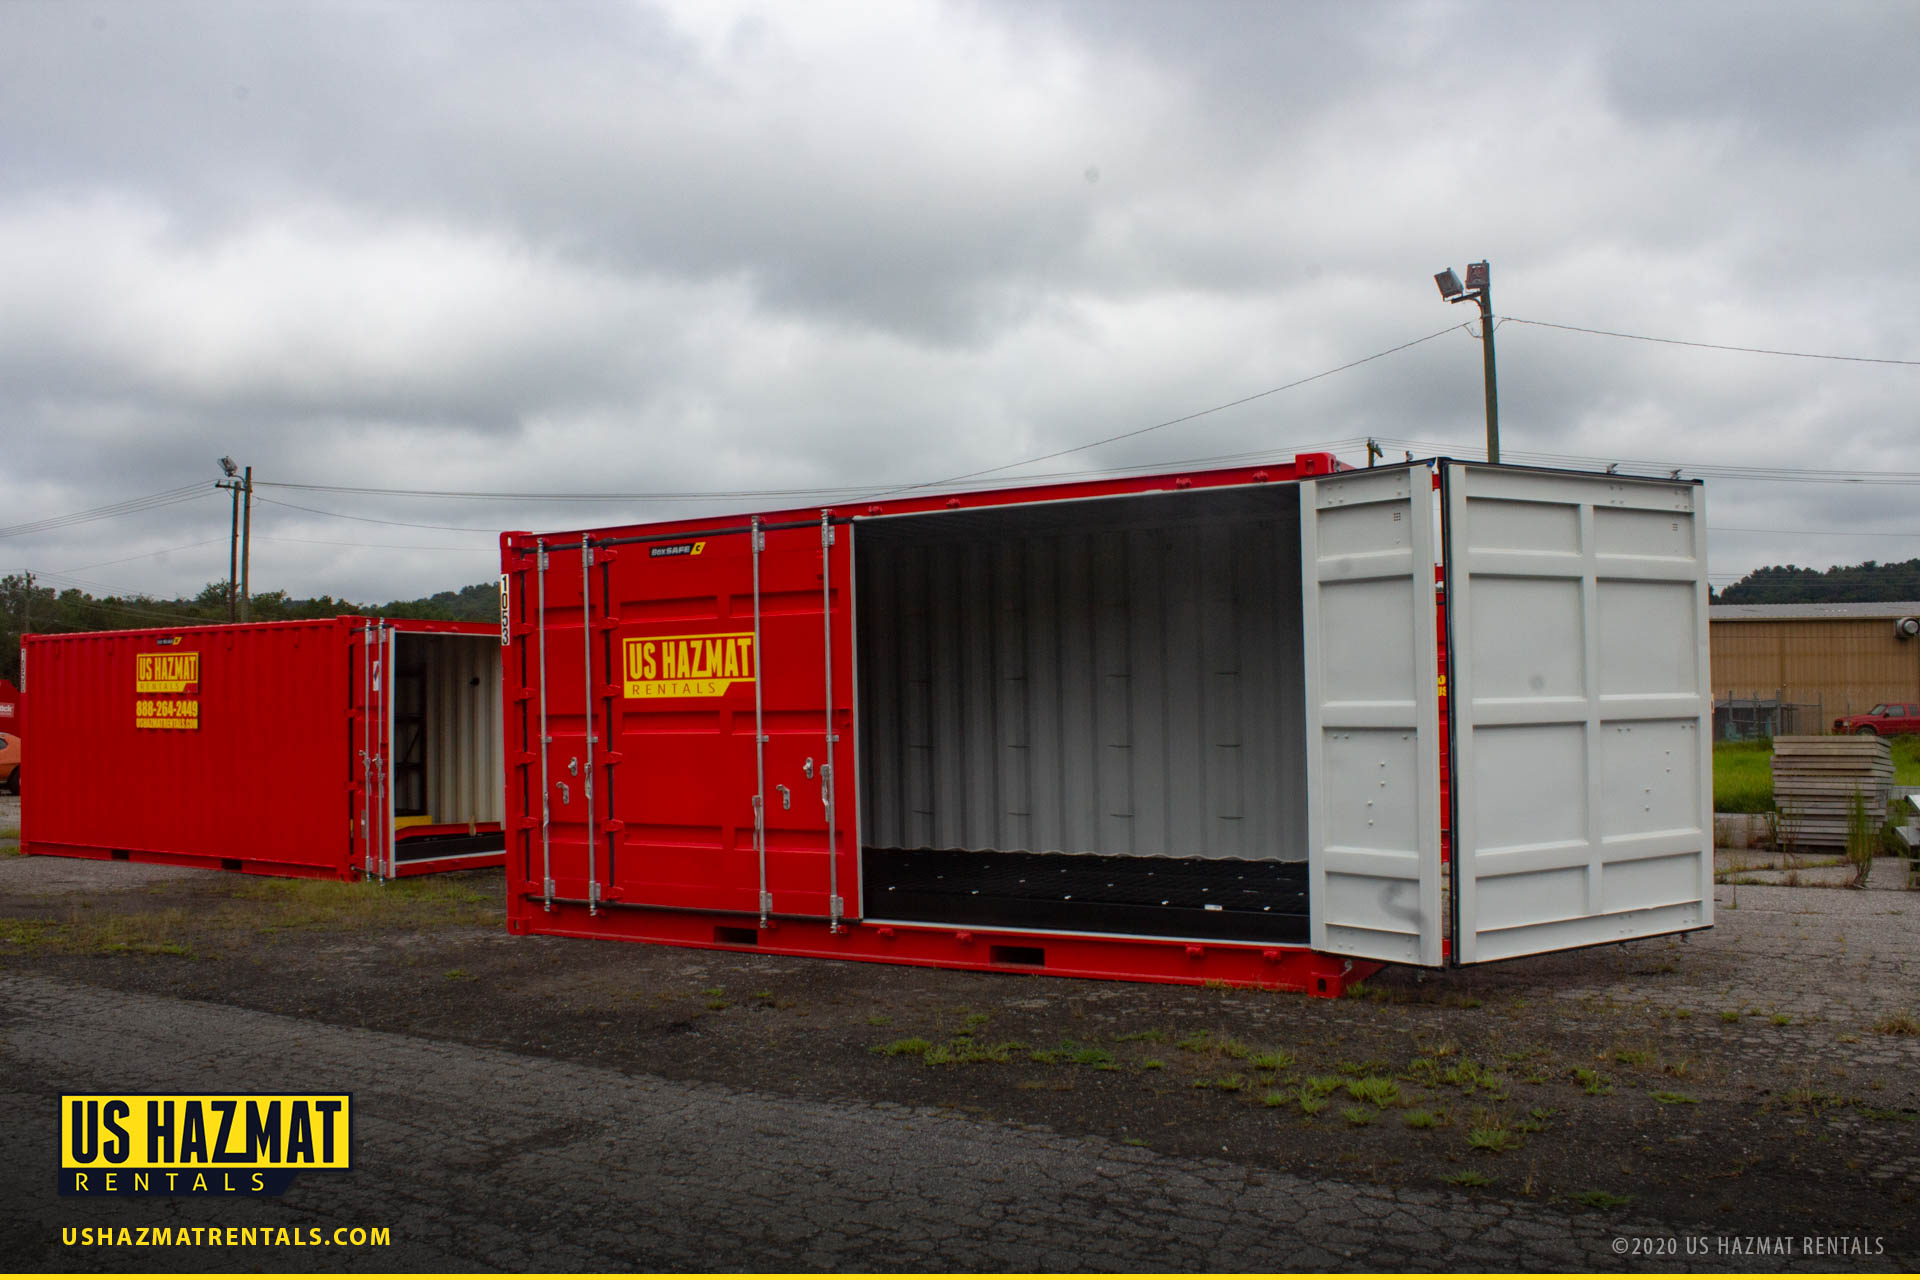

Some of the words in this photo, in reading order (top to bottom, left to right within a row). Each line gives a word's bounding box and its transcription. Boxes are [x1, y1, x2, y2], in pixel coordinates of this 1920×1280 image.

[501, 575, 509, 645] 1053
[139, 657, 152, 681] US
[154, 656, 196, 681] HAZMAT
[629, 642, 656, 680] US
[662, 638, 752, 679] HAZMAT
[632, 682, 716, 695] RENTALS
[136, 700, 198, 717] 888-264-2449
